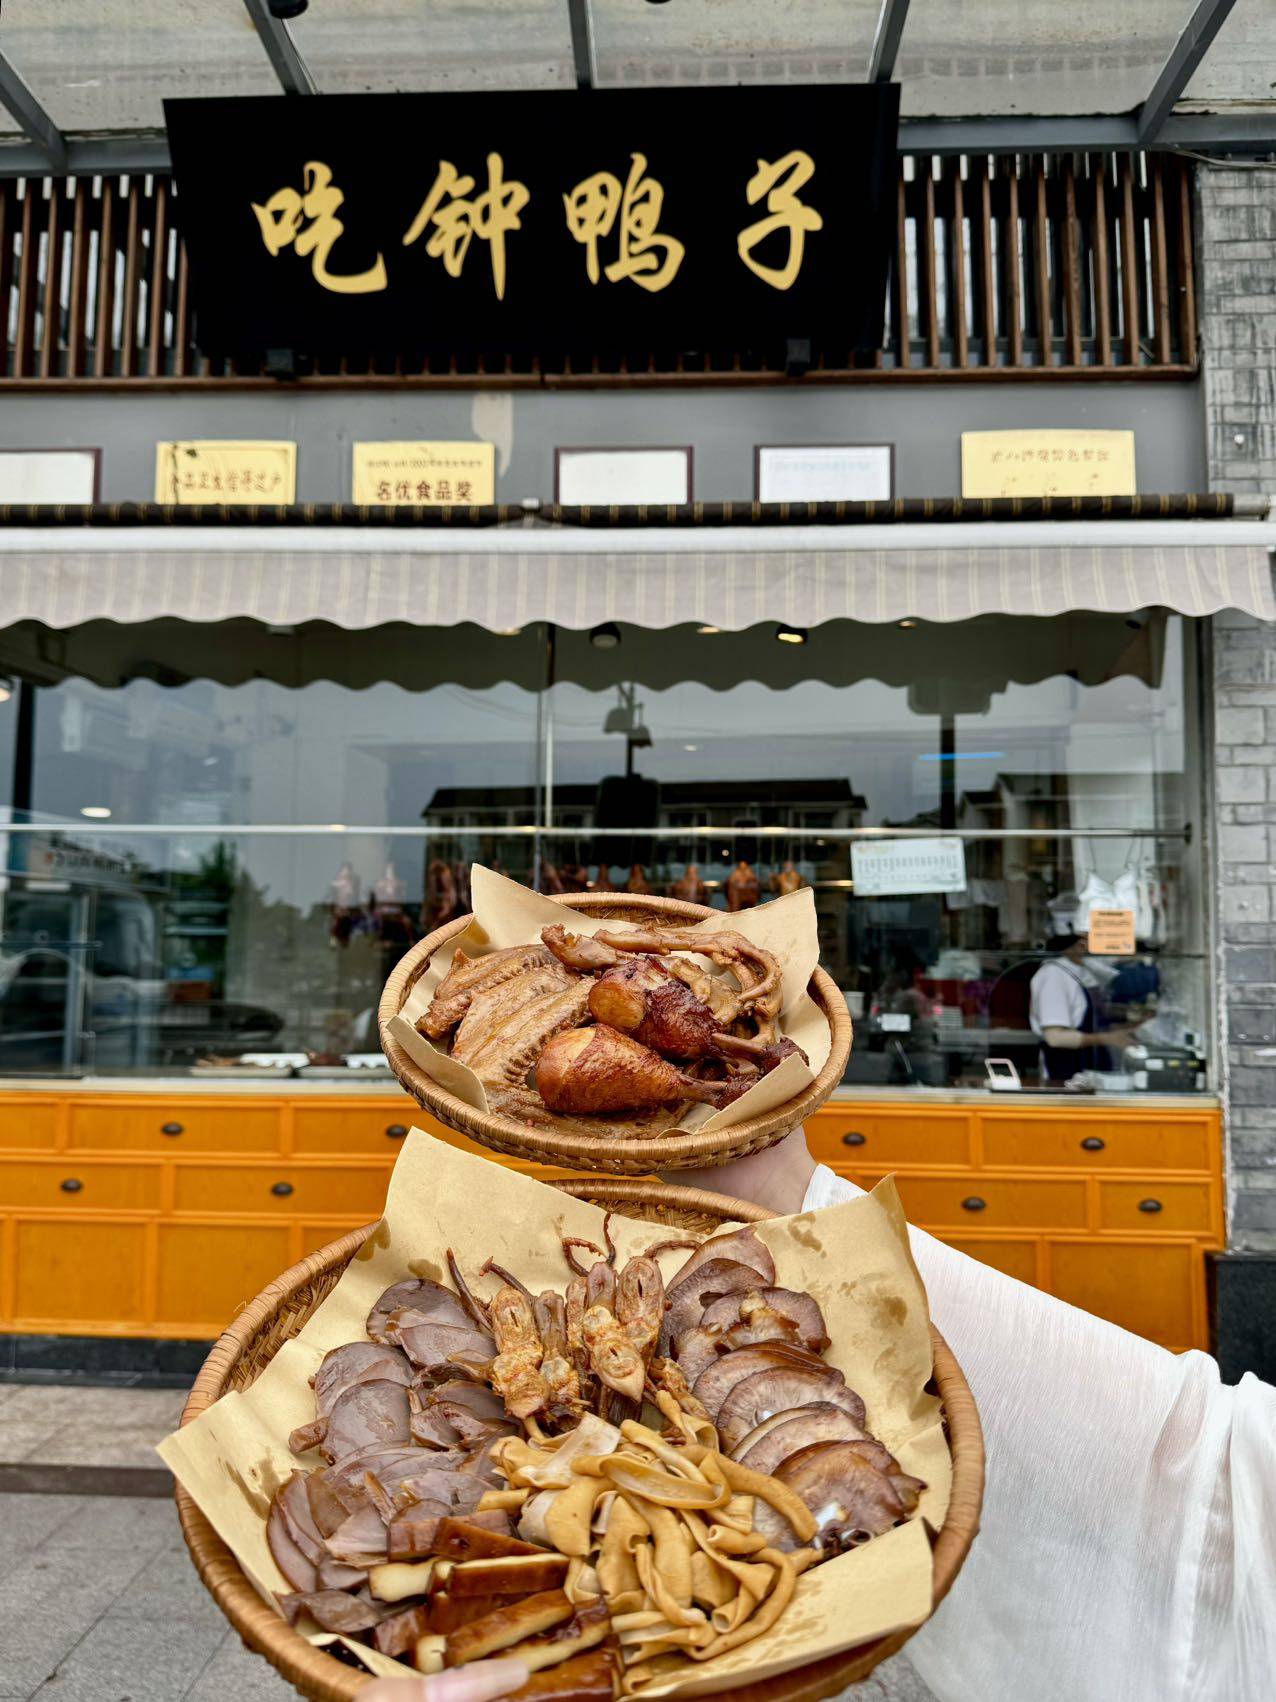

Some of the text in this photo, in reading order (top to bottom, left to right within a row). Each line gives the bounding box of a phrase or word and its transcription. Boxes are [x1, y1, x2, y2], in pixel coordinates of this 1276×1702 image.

[377, 480, 472, 502] 名优食品奖
